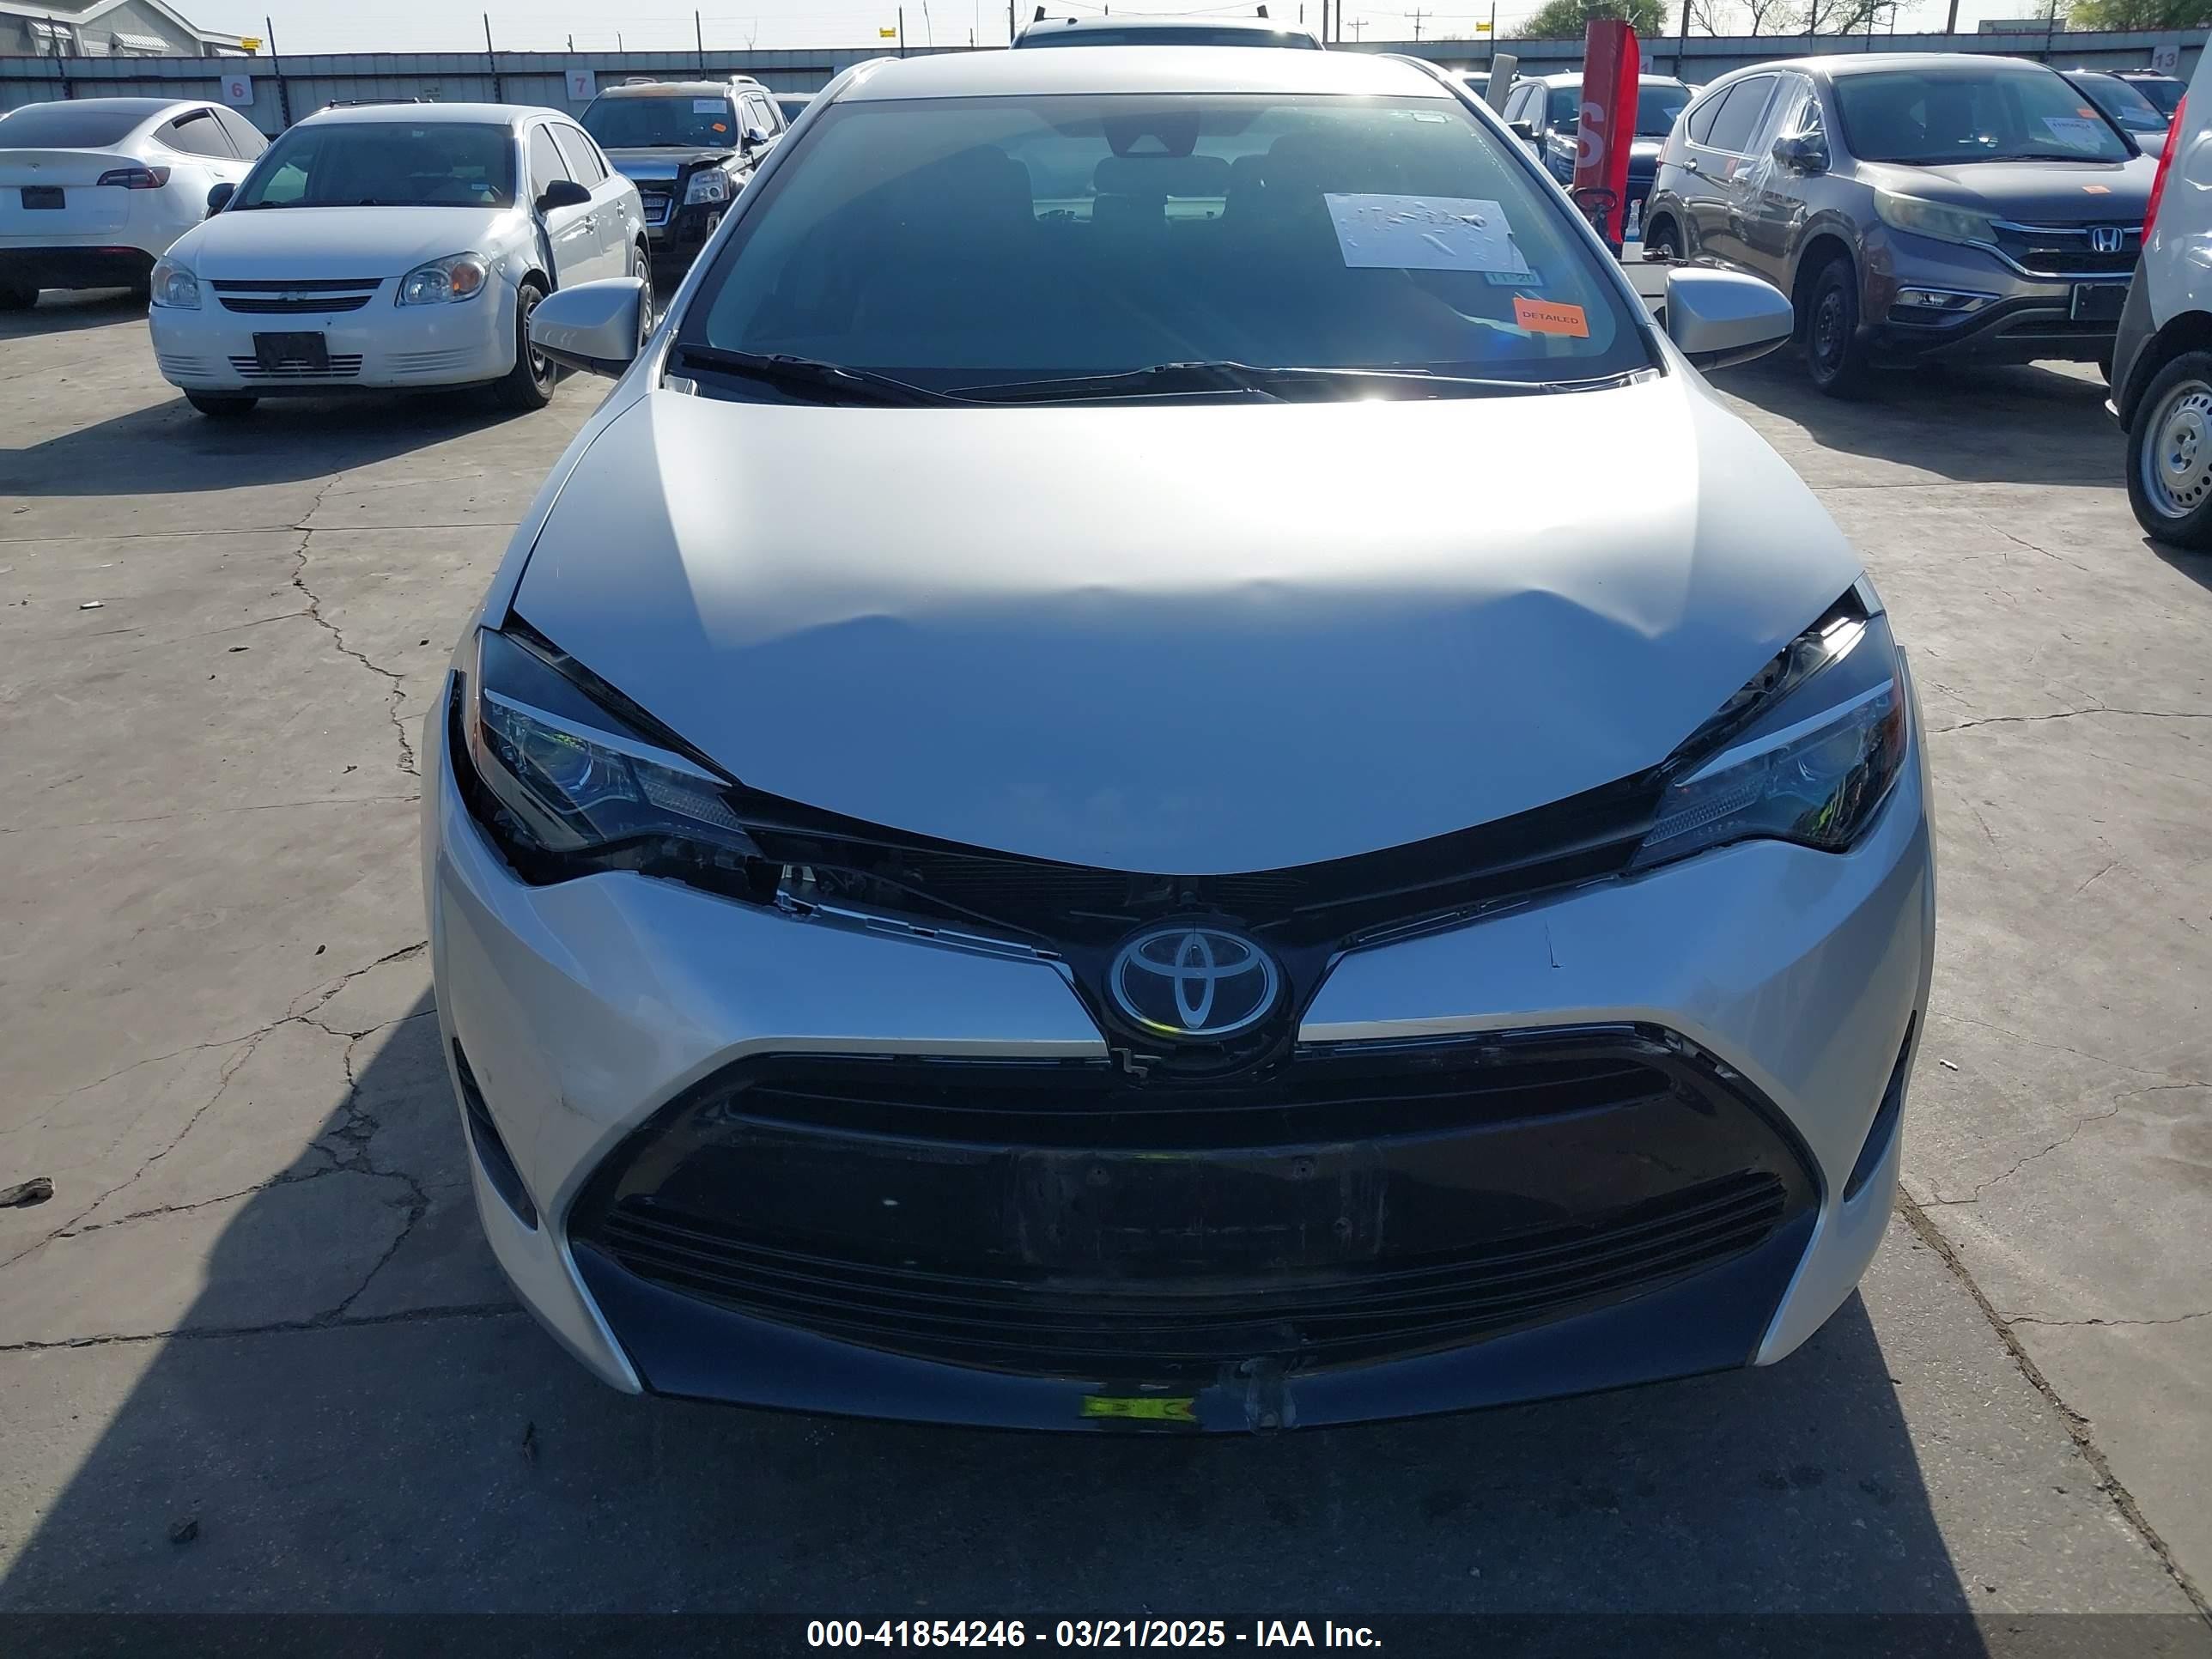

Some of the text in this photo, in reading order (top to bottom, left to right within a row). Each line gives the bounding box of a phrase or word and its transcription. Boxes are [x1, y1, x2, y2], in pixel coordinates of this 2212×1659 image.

[2155, 52, 2176, 68] 13
[232, 82, 244, 98] 6
[575, 77, 586, 93] 7
[1577, 101, 1605, 168] S
[1522, 311, 1579, 325] DETAILED
